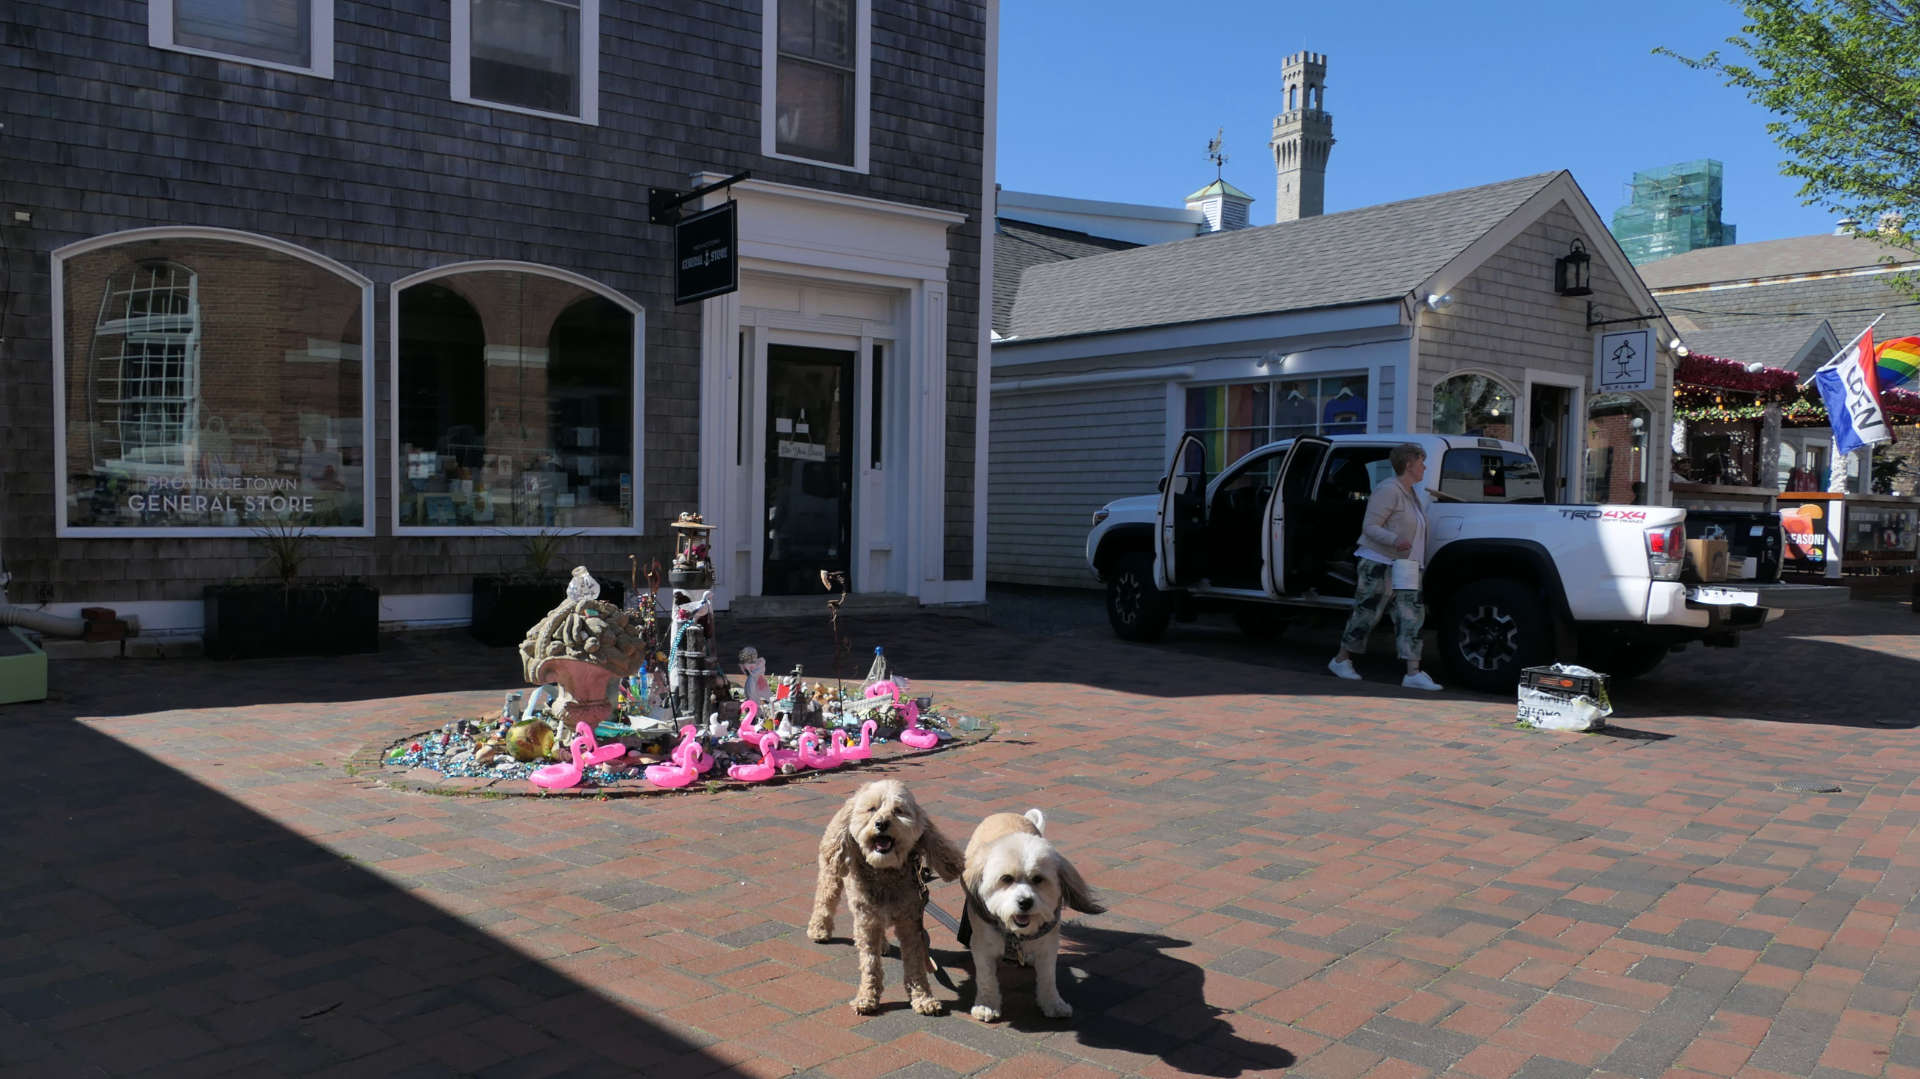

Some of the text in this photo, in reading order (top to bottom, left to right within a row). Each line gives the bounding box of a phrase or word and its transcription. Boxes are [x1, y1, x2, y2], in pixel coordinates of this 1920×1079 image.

[147, 477, 297, 490] PROVINCETOWN
[128, 494, 314, 513] GENERAL STORE
